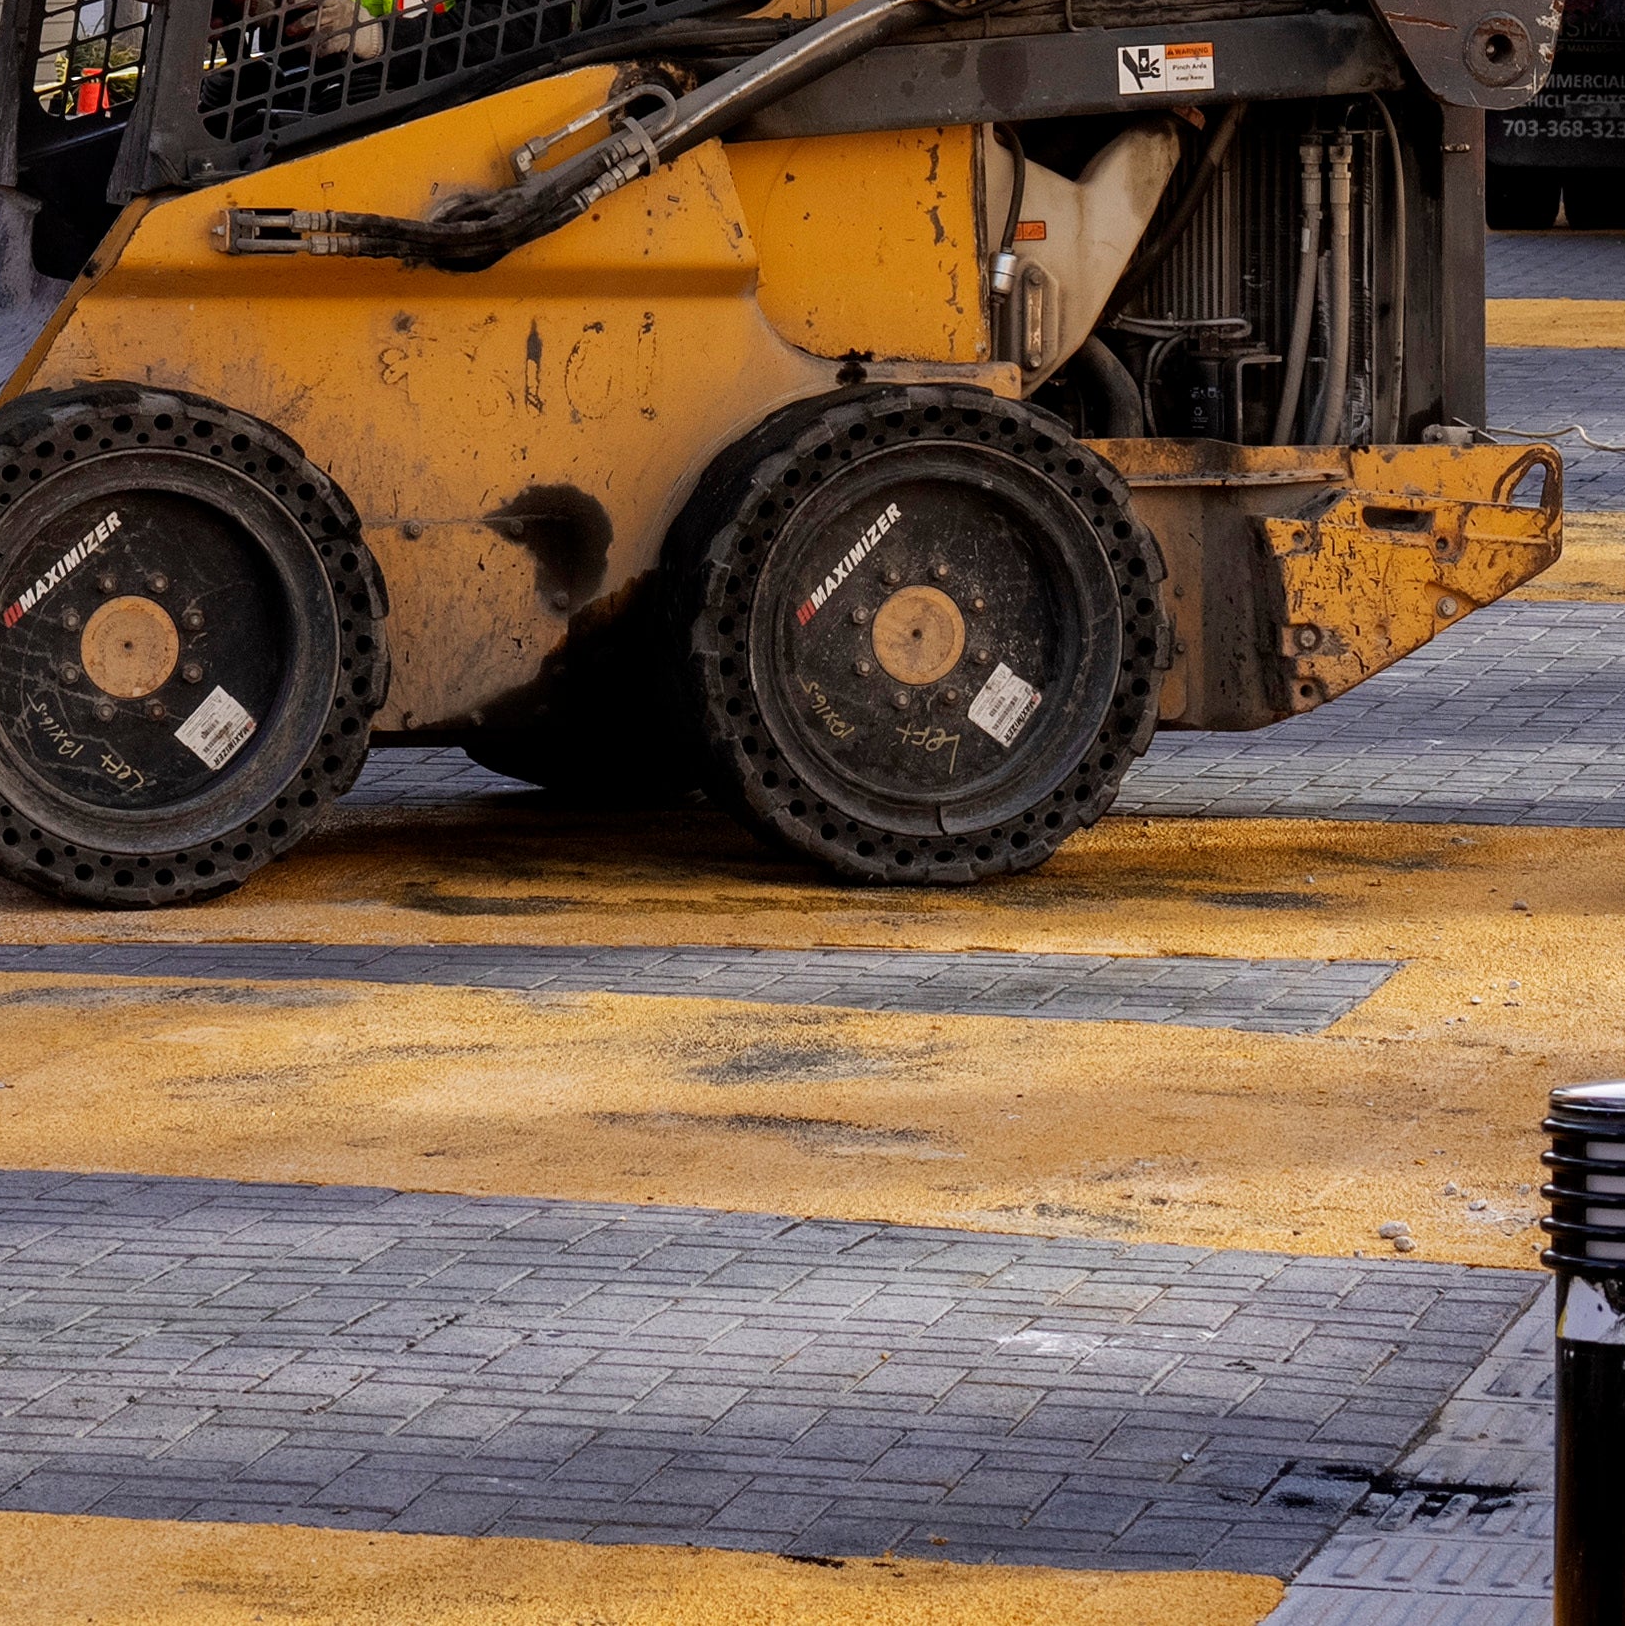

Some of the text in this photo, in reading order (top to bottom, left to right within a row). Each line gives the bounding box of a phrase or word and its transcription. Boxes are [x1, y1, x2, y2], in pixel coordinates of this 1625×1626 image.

[1175, 47, 1209, 55] WARNING
[19, 510, 123, 614] MAXIMIZER
[810, 502, 903, 611] MAXIMIZER
[1002, 699, 1036, 743] MAXIMIZER
[212, 723, 250, 769] MAXIMIZER
